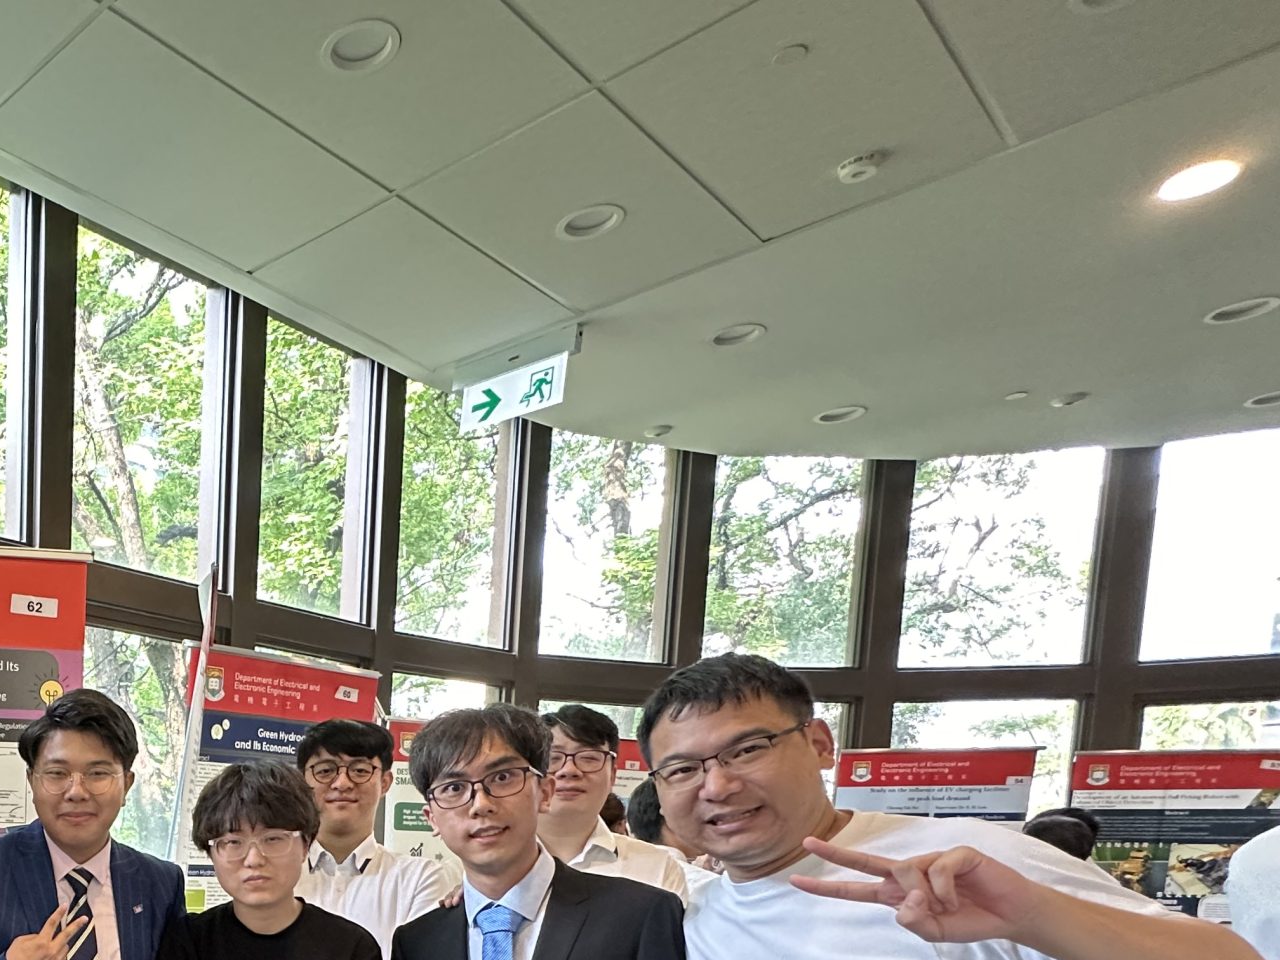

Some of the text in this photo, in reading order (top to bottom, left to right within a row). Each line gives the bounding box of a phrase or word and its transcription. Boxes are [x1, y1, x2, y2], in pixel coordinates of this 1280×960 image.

[27, 601, 43, 613] 62
[6, 661, 20, 671] Its
[235, 672, 272, 685] Department
[280, 679, 308, 690] Electrical
[309, 684, 320, 692] and
[234, 682, 301, 699] Electronic Engineering
[258, 728, 279, 739] Green
[235, 740, 251, 750] and
[263, 743, 296, 754] Economic
[881, 761, 918, 769] Department
